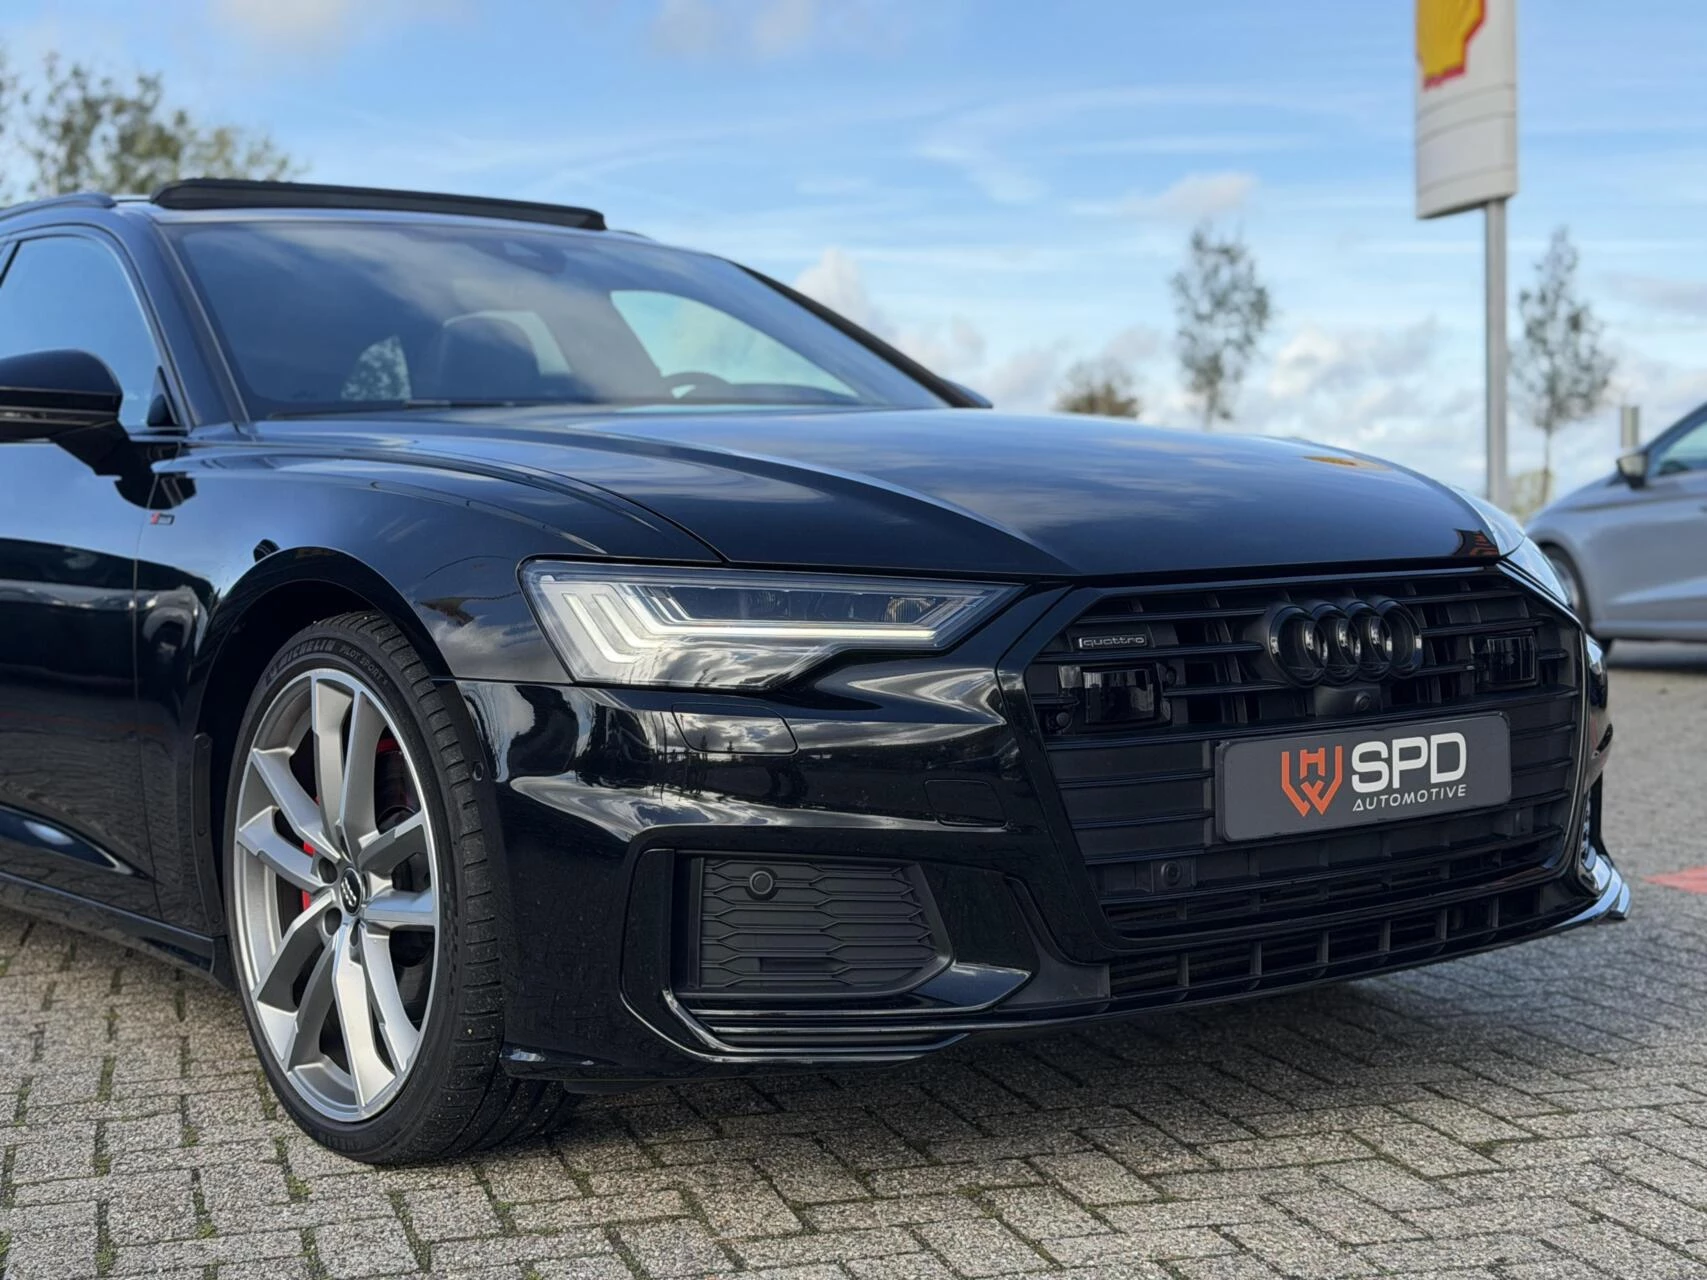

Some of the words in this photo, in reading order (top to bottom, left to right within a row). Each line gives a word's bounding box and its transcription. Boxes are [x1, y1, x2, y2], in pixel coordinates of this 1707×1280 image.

[1083, 636, 1145, 648] quattro
[360, 656, 384, 680] SPORT
[1351, 732, 1467, 794] SPD
[1352, 784, 1467, 812] AUTOMOTIVE
